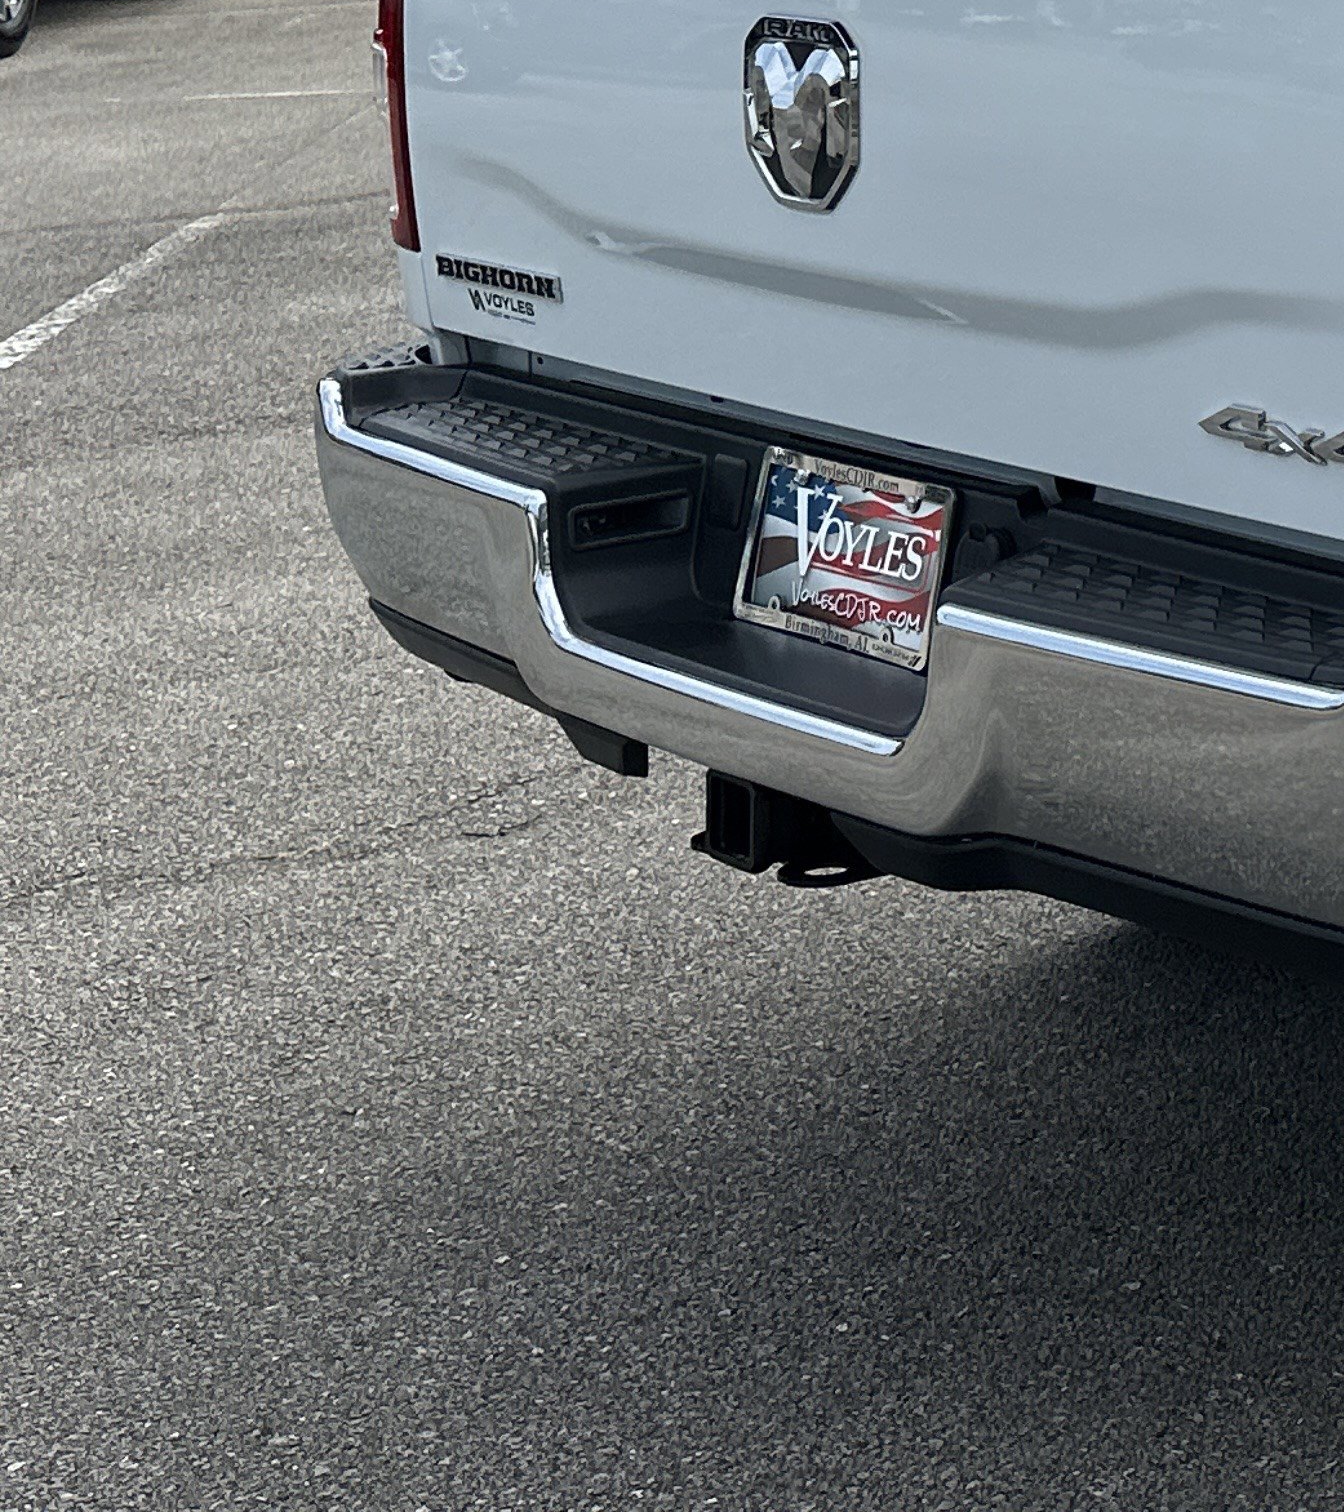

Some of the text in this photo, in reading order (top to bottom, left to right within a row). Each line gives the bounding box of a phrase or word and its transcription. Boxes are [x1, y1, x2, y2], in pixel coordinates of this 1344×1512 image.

[763, 18, 836, 43] RAM
[436, 254, 559, 300] BIGHORN
[483, 290, 535, 317] VOYLES
[797, 486, 926, 581] VOYLES
